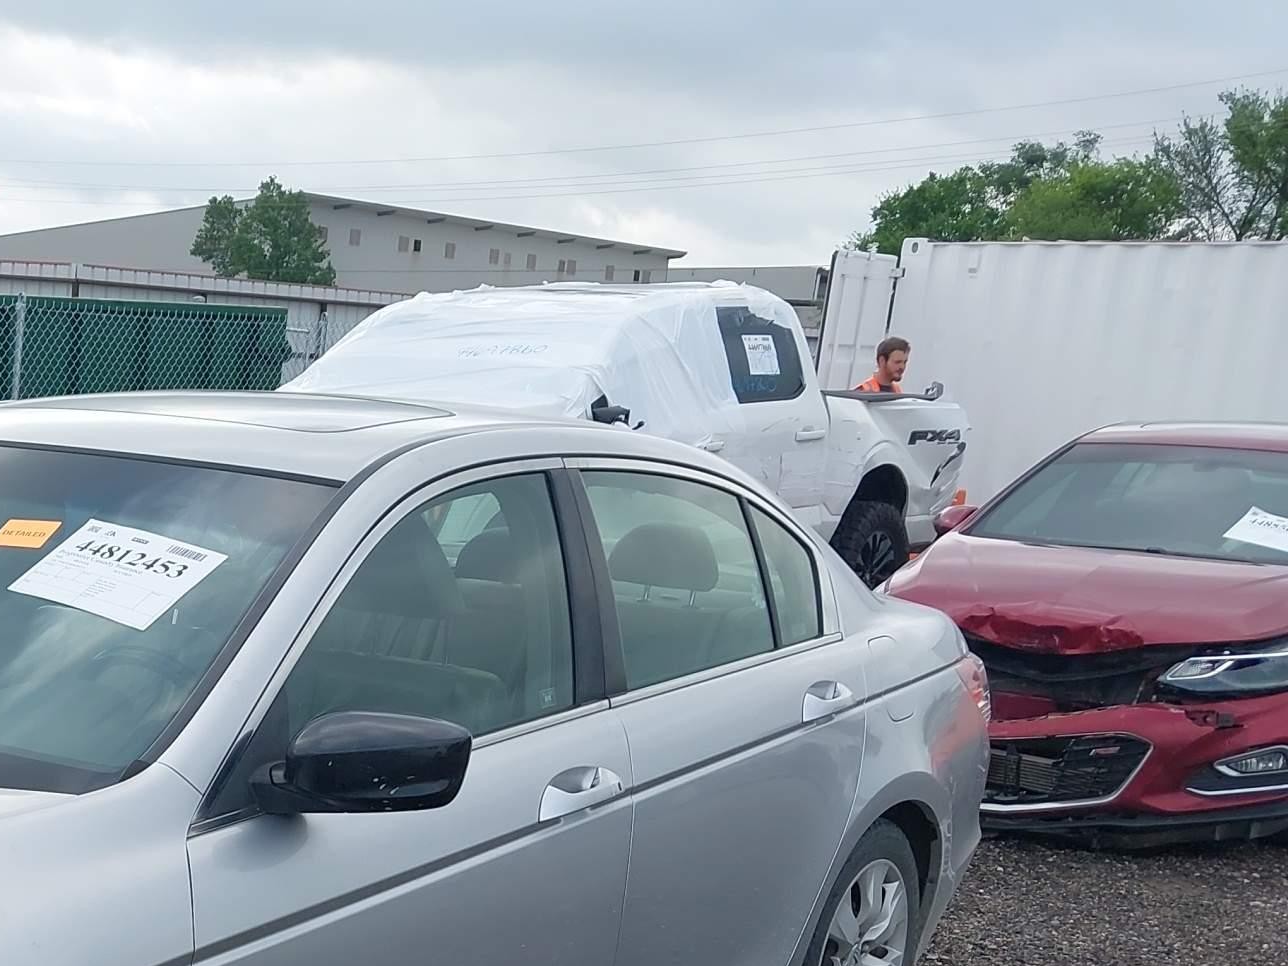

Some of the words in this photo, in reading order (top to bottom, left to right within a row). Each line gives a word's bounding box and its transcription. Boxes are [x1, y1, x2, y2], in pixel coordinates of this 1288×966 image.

[908, 429, 961, 445] FX4
[2, 529, 47, 537] DETAILED
[75, 540, 189, 578] 44812453
